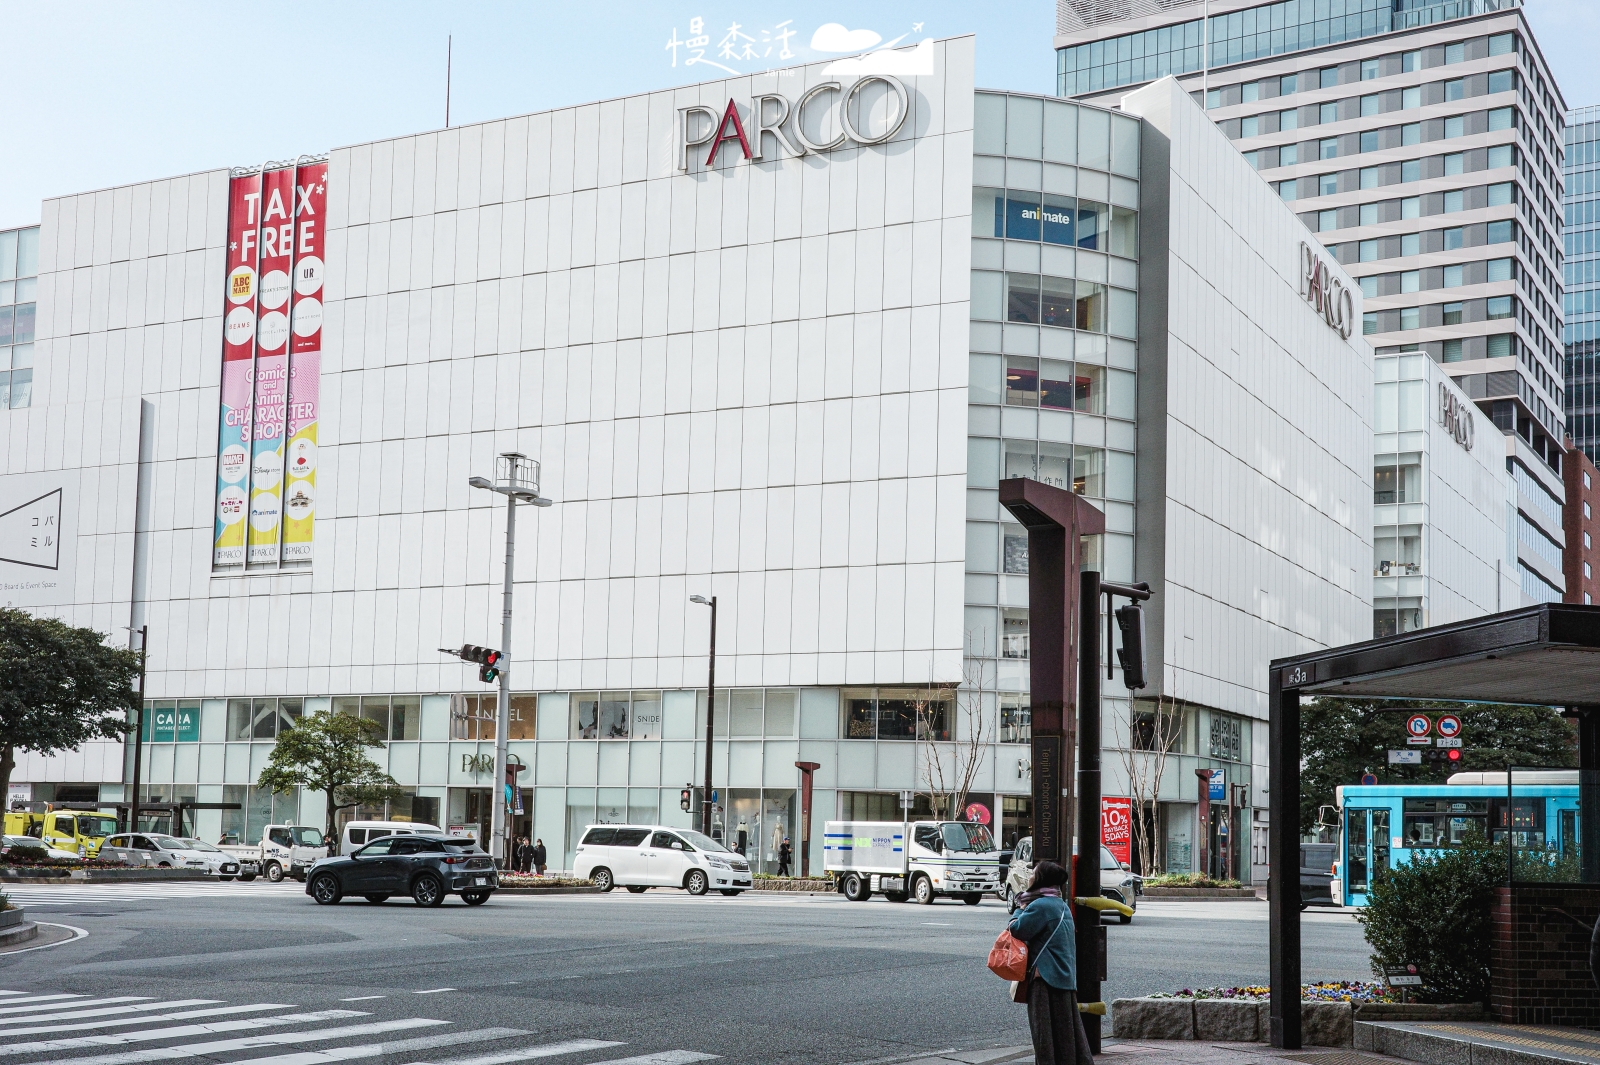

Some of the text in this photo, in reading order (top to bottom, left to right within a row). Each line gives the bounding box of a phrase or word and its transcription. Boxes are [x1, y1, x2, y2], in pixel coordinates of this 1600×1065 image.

[677, 74, 909, 171] PARCO
[244, 182, 316, 225] TAX
[1021, 206, 1070, 224] animate
[242, 220, 315, 262] FREE
[303, 267, 314, 278] UR
[233, 276, 250, 288] ABC
[232, 286, 250, 294] MART
[1299, 240, 1354, 340] PARCO
[228, 322, 250, 330] BEAMS
[246, 364, 296, 384] Comics
[263, 380, 277, 390] and
[245, 390, 294, 408] Anime
[225, 402, 315, 426] CHARACTER
[1438, 381, 1475, 452] PARCO
[240, 420, 296, 442] SHOPS
[223, 454, 244, 466] MARVEL
[254, 466, 270, 475] Disney
[220, 550, 242, 558] PARCO
[254, 548, 275, 556] PARCO
[289, 546, 310, 555] PARCO
[42, 580, 56, 589] Space
[475, 708, 524, 721] NEL
[1211, 718, 1238, 738] JORAL
[462, 753, 520, 773] PAR
[1040, 749, 1051, 847] Tenjin 1-chome Chuo-ku
[1102, 810, 1128, 828] 10%
[1104, 824, 1128, 833] PAYBACK
[1104, 830, 1130, 842] 5DAYS
[854, 838, 872, 848] NX
